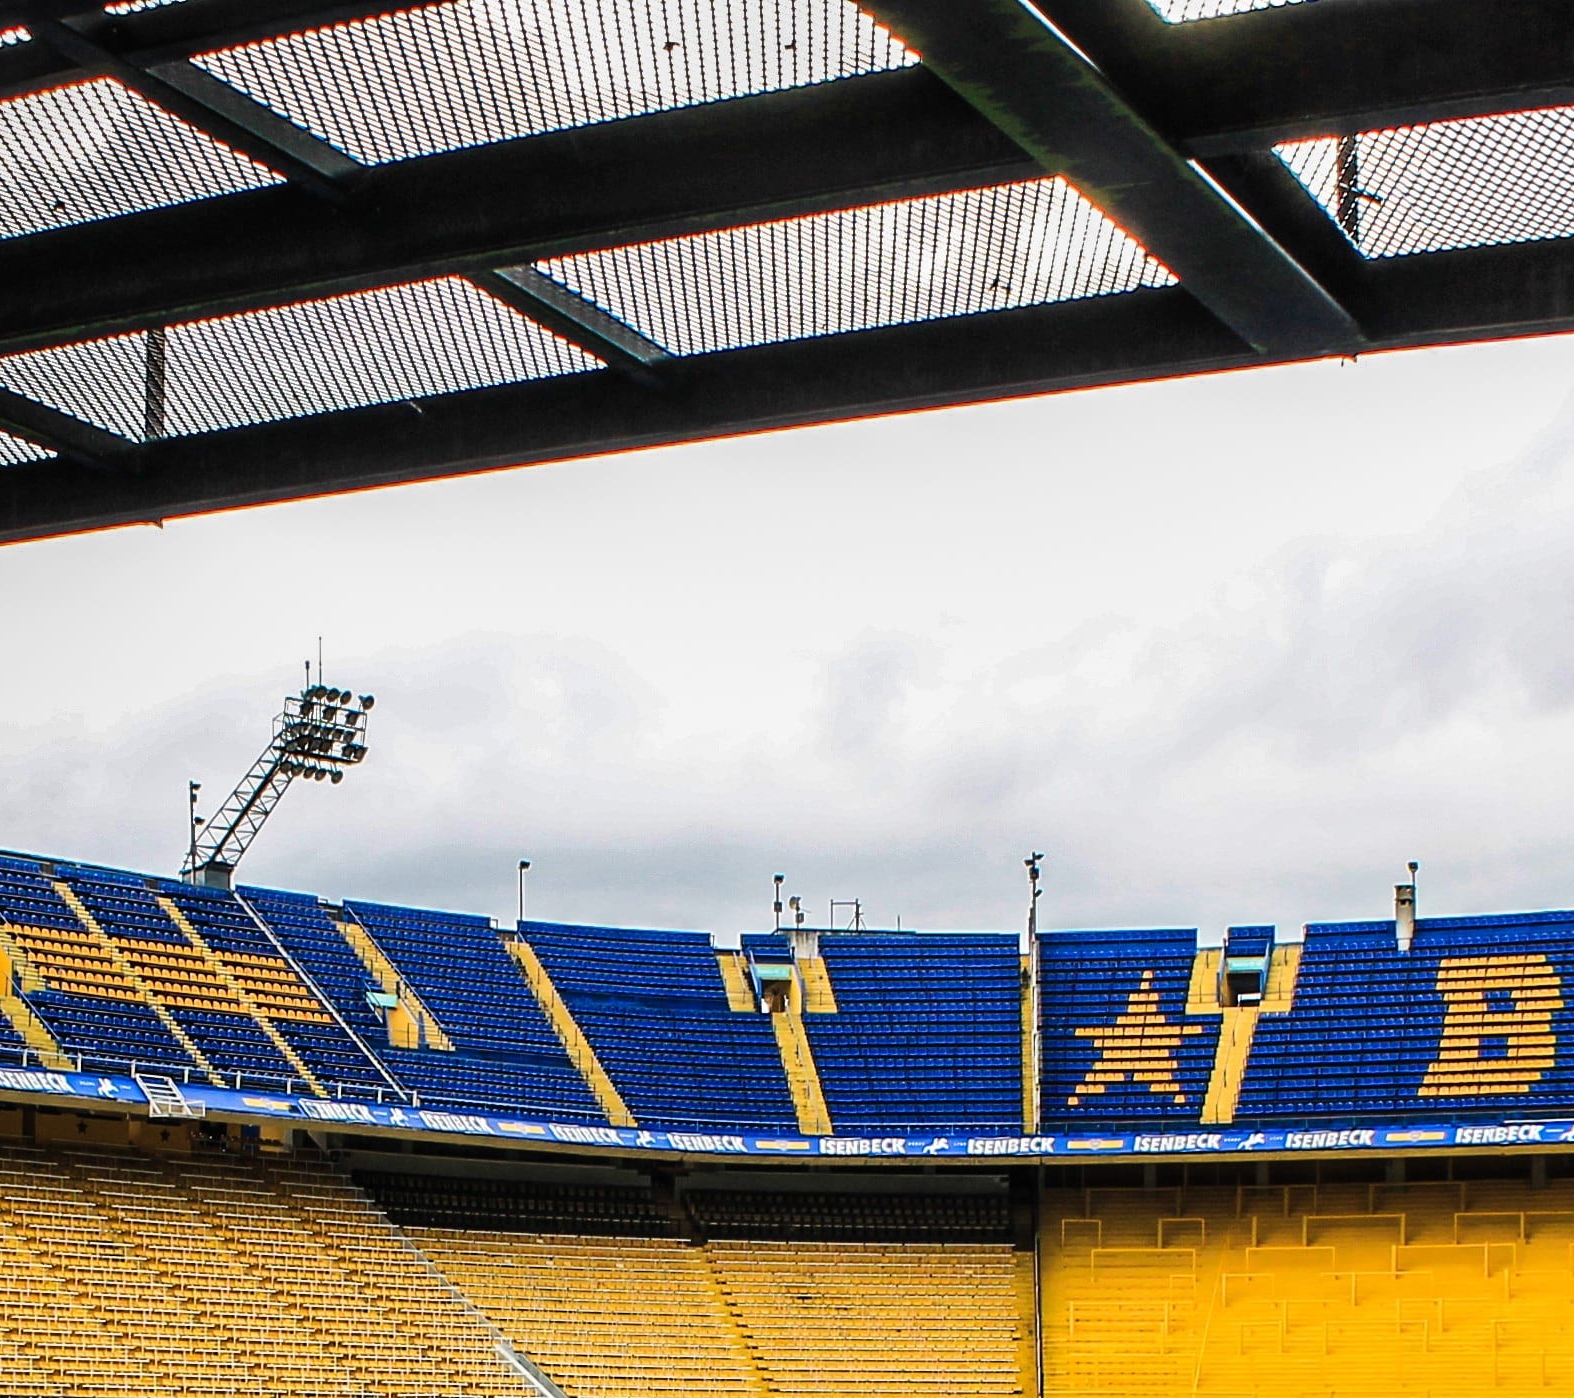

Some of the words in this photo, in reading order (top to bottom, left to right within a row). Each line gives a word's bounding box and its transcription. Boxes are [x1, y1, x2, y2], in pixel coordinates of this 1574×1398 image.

[420, 1111, 495, 1135] ISENBECK
[667, 1130, 749, 1153] ISENBECK
[1133, 1133, 1223, 1152] ISENBECK
[1284, 1129, 1375, 1150] ISENBECK
[1455, 1124, 1545, 1144] ISENBECK
[819, 1137, 907, 1155] ISENBECK
[967, 1136, 1056, 1155] ISENBECK
